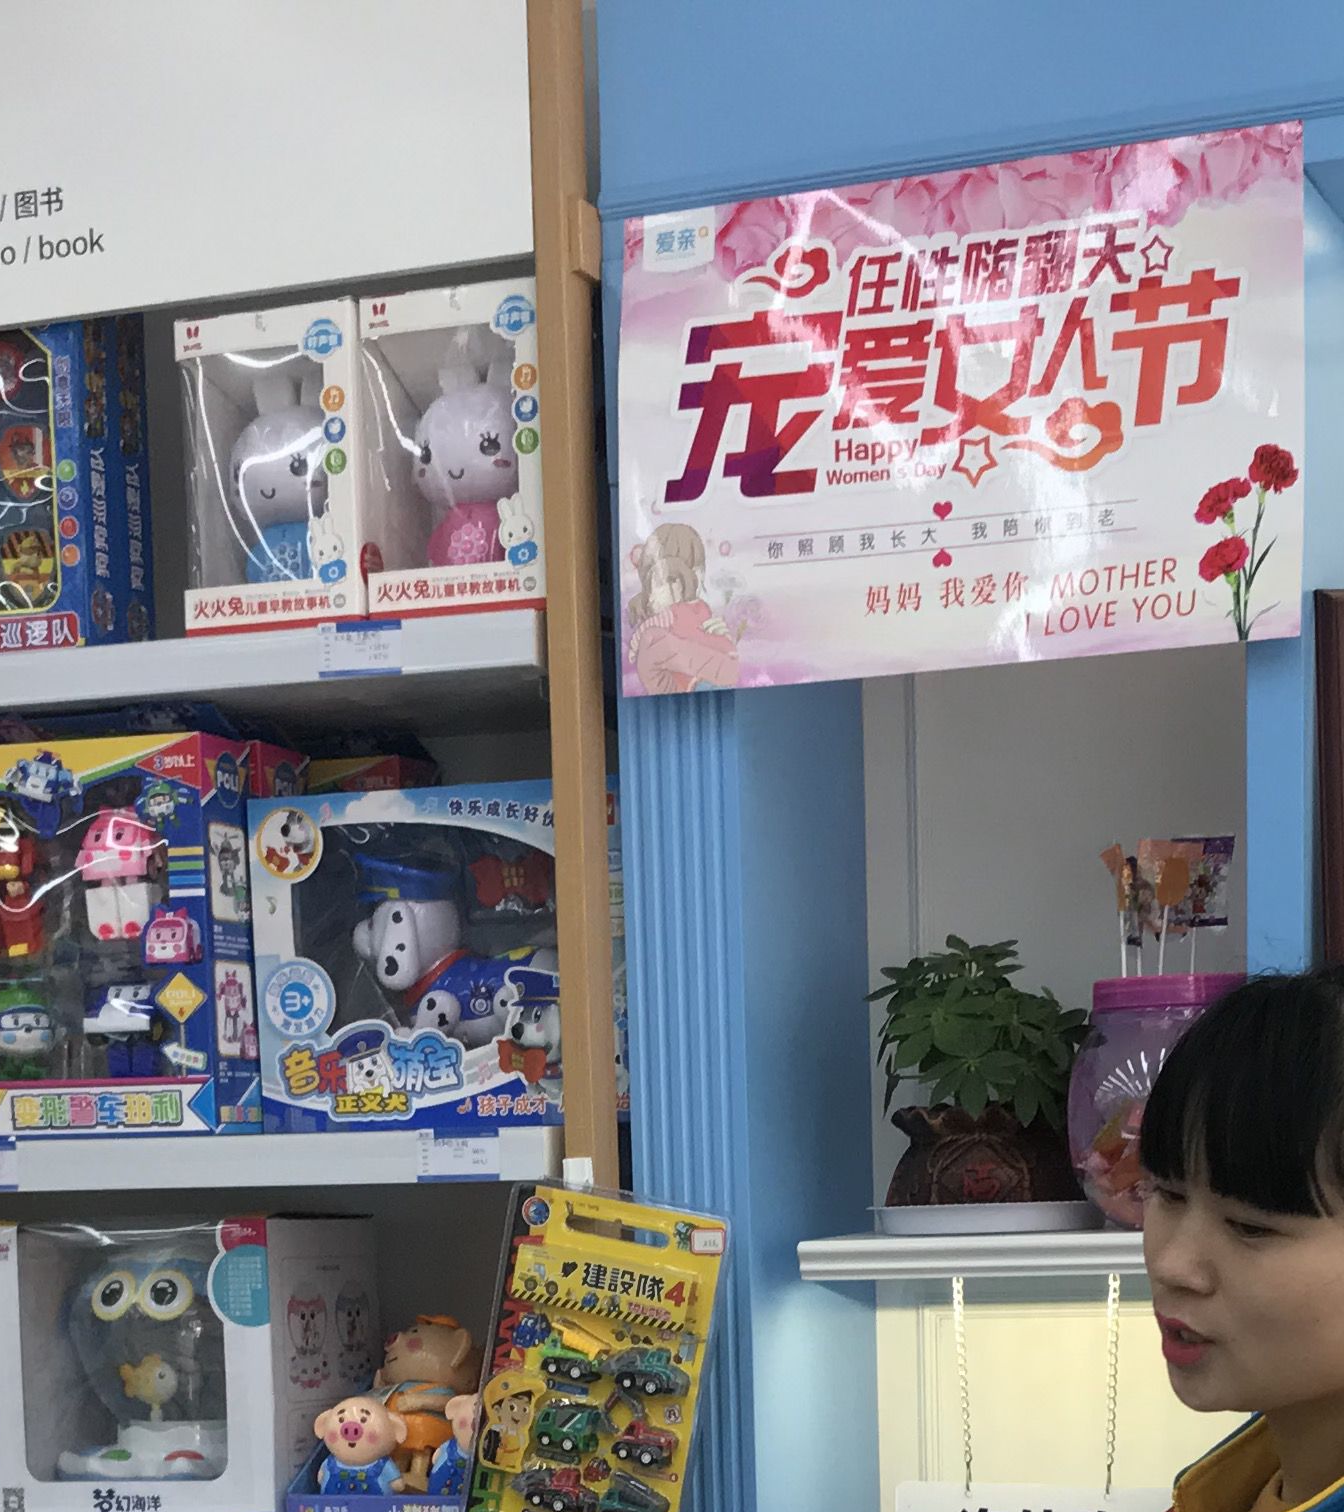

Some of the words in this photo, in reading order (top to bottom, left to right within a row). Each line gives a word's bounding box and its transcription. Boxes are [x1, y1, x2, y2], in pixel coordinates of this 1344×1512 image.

[13, 187, 64, 221] 图书
[37, 227, 106, 262] book
[655, 227, 698, 256] 爱亲
[849, 215, 1140, 318] 任性嗨翻天
[664, 266, 1240, 504] 宠爱女人节
[834, 438, 918, 465] Happy
[913, 462, 947, 480] Day
[767, 527, 938, 560] 你照顾我长大
[971, 507, 1115, 541] 我陪你到老
[377, 577, 522, 604] 火火兔儿童早教故事机
[865, 582, 923, 617] 妈妈
[939, 571, 1030, 610] 我爱你
[1050, 557, 1178, 599] MOTHER
[193, 594, 332, 620] 火火兔儿童早教故事机
[1044, 601, 1117, 637] LOVE
[1132, 588, 1199, 623] YOU
[477, 1094, 548, 1118] 孩子成才
